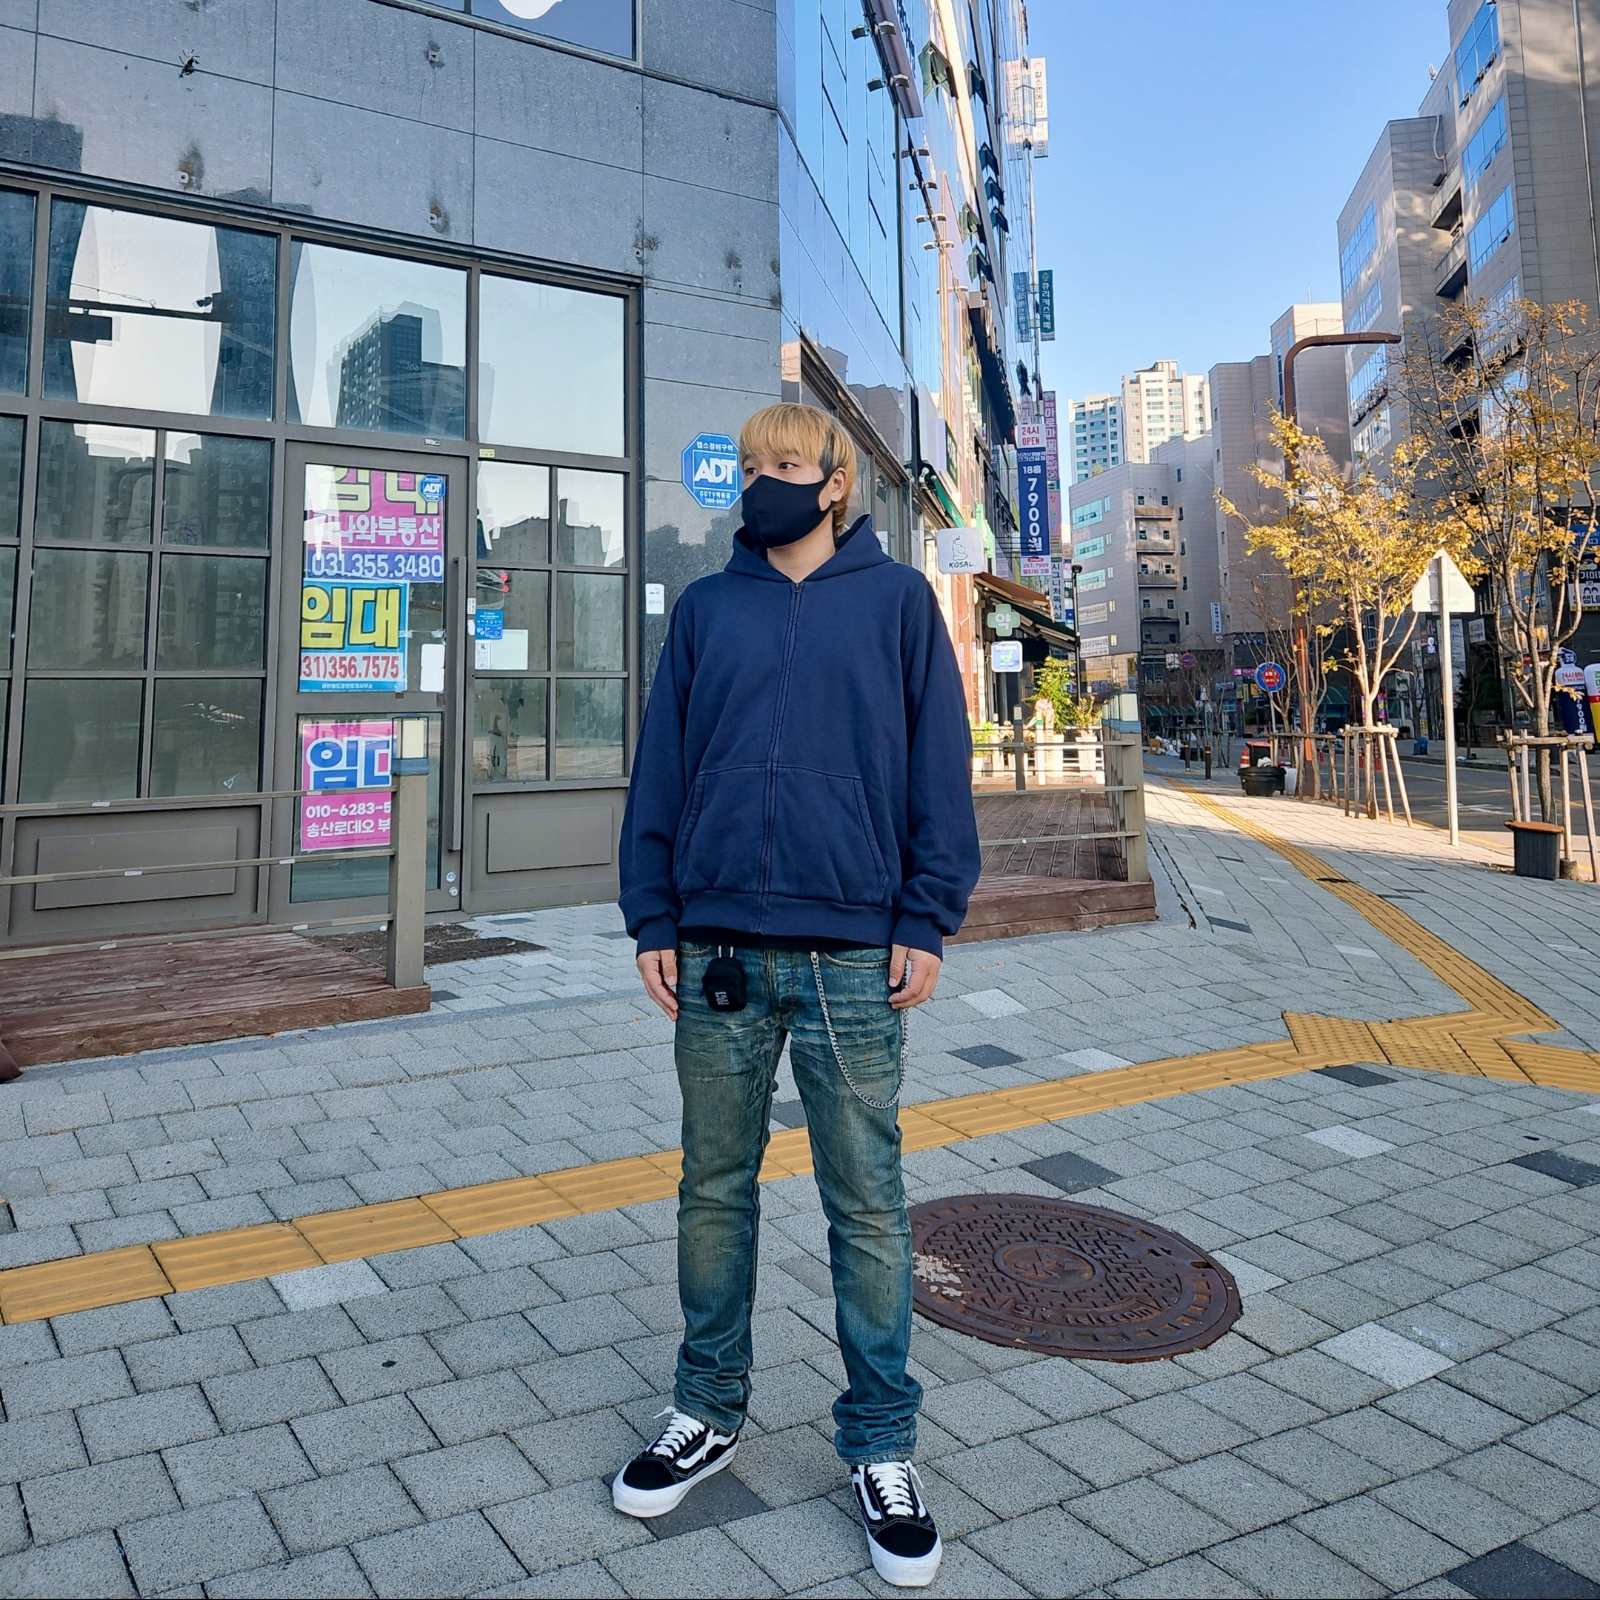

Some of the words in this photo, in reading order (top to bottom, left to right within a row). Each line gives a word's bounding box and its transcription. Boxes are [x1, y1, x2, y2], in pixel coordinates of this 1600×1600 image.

[1021, 426, 1039, 435] 24시
[1022, 436, 1040, 446] OPEN
[693, 457, 737, 485] ADT
[423, 482, 442, 494] ADT
[311, 552, 443, 578] 031.355.3480
[948, 560, 975, 569] KOSAL
[1051, 563, 1062, 620] 시그니처독서실
[301, 584, 401, 650] 임대
[994, 613, 1012, 630] 약
[300, 655, 399, 679] 31)356.7575
[306, 819, 375, 838] 송산로데오
[1013, 1303, 1051, 1321] SK
[1064, 1304, 1153, 1325] telecom
